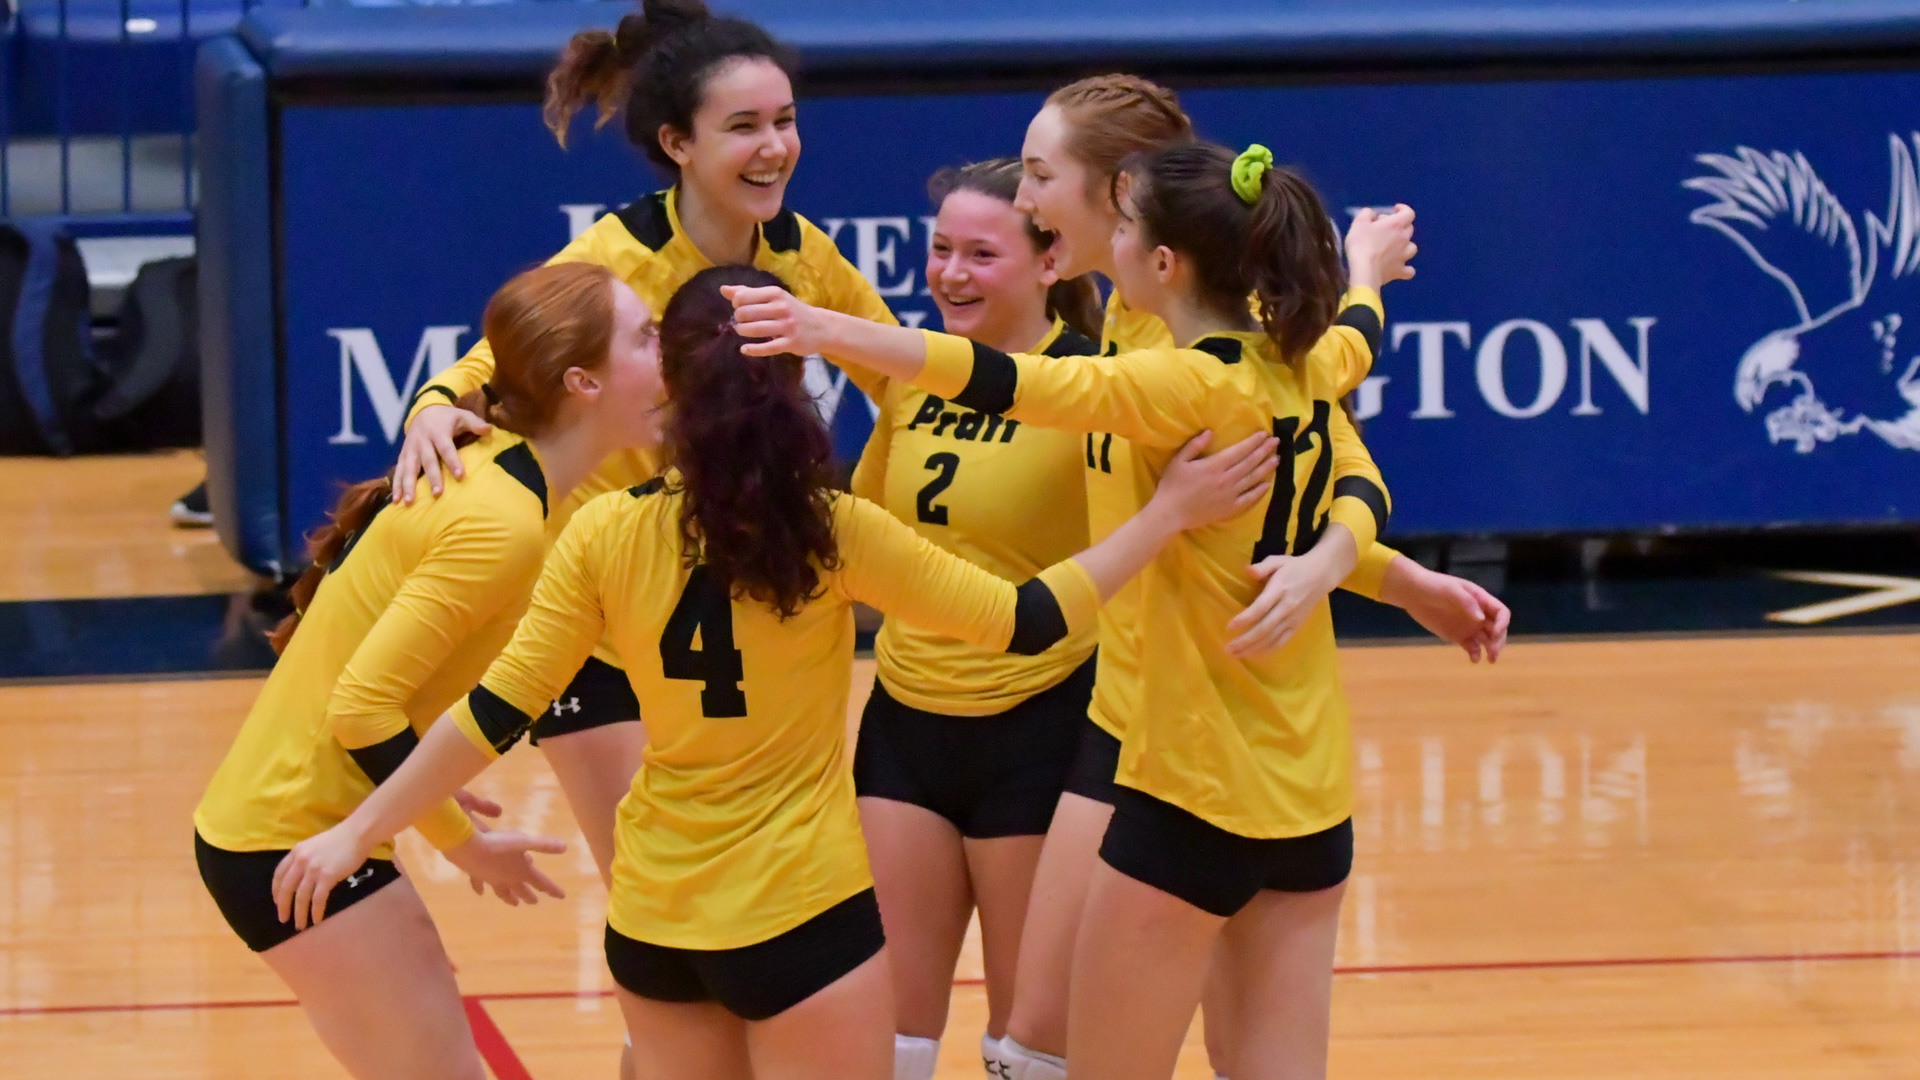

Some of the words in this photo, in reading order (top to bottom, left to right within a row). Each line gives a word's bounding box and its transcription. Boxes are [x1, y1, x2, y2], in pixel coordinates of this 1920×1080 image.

[917, 452, 960, 525] 2
[1251, 400, 1332, 565] 12
[659, 564, 747, 718] 4
